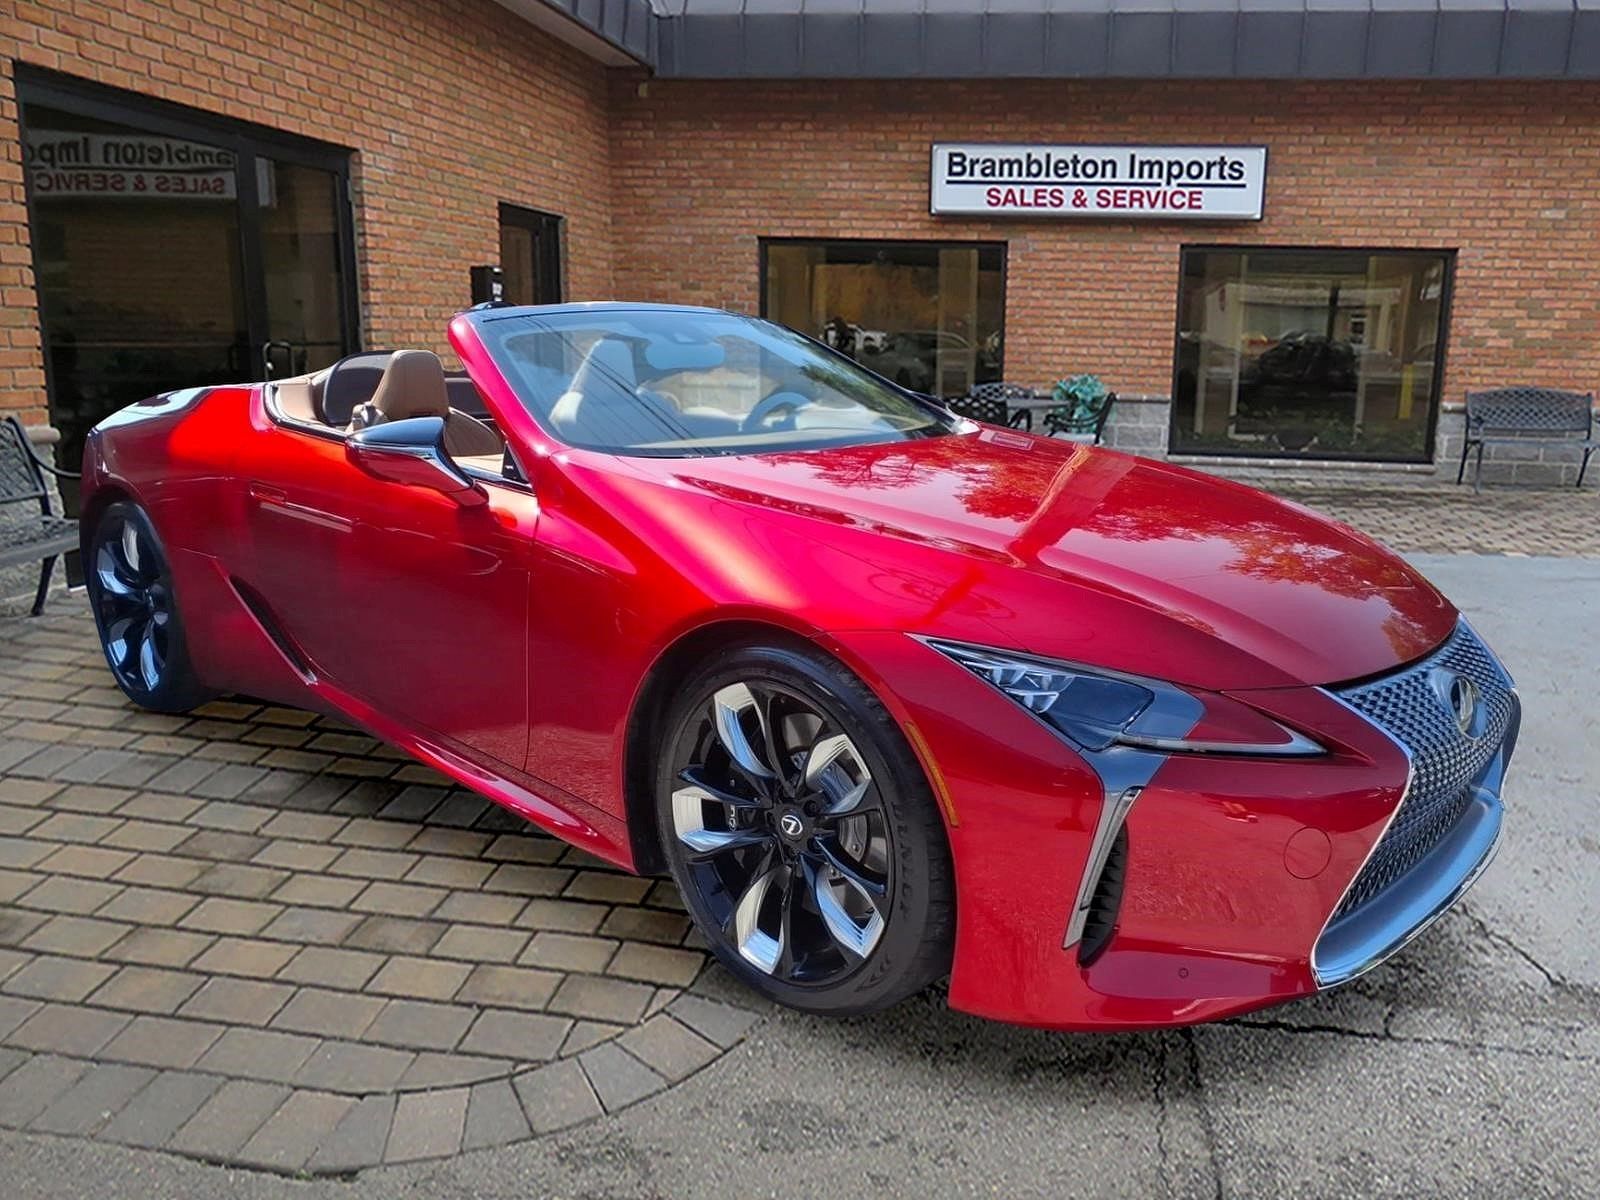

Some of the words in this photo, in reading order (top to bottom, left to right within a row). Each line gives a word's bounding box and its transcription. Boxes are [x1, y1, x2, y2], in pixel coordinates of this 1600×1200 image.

[948, 152, 1117, 179] Brambleton
[1129, 153, 1245, 186] Imports
[986, 187, 1064, 207] SALES
[1071, 188, 1088, 208] &
[1096, 189, 1203, 210] SERVICE
